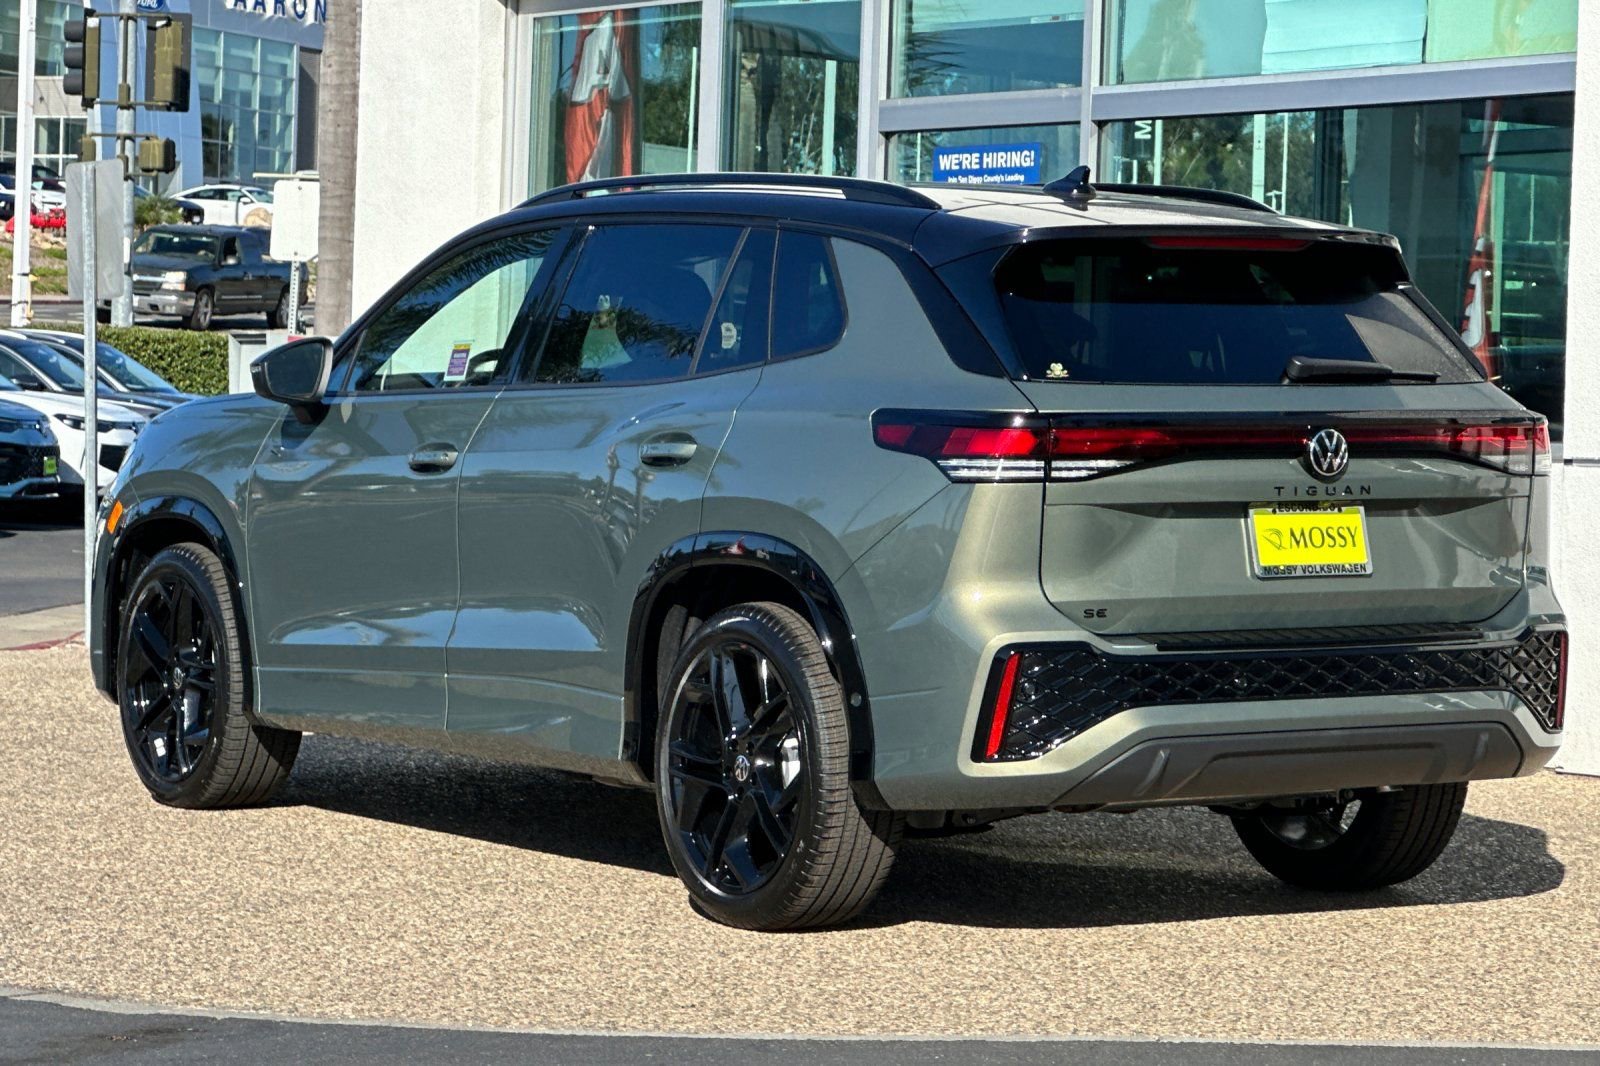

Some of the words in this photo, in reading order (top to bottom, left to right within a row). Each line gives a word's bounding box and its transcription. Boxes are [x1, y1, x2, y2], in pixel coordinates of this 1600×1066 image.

[939, 153, 980, 171] WE'RE
[982, 150, 1035, 169] HIRING!
[1274, 485, 1372, 497] TIGUAN
[1289, 525, 1358, 550] MOSSY
[1263, 564, 1298, 576] MOSSY
[1300, 563, 1367, 575] VOLKSWAGEN
[1083, 608, 1108, 619] SE
